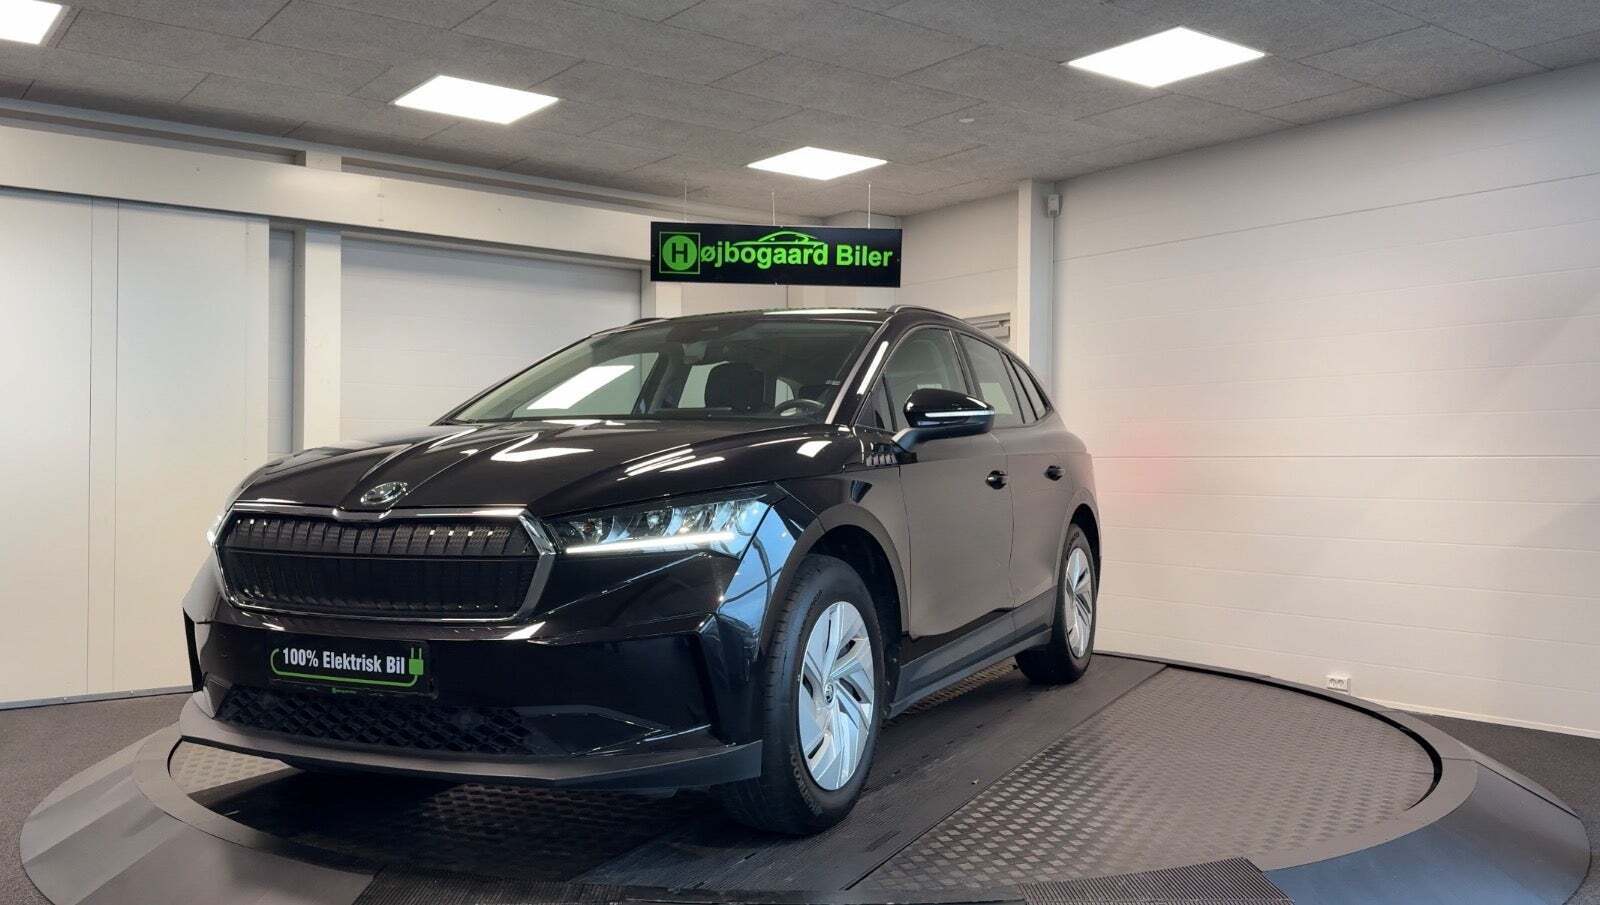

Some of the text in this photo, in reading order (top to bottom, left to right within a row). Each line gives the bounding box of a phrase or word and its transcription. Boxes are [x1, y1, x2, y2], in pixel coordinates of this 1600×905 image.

[836, 244, 893, 267] Biler
[283, 647, 405, 675] 100% Elektrisk Bil
